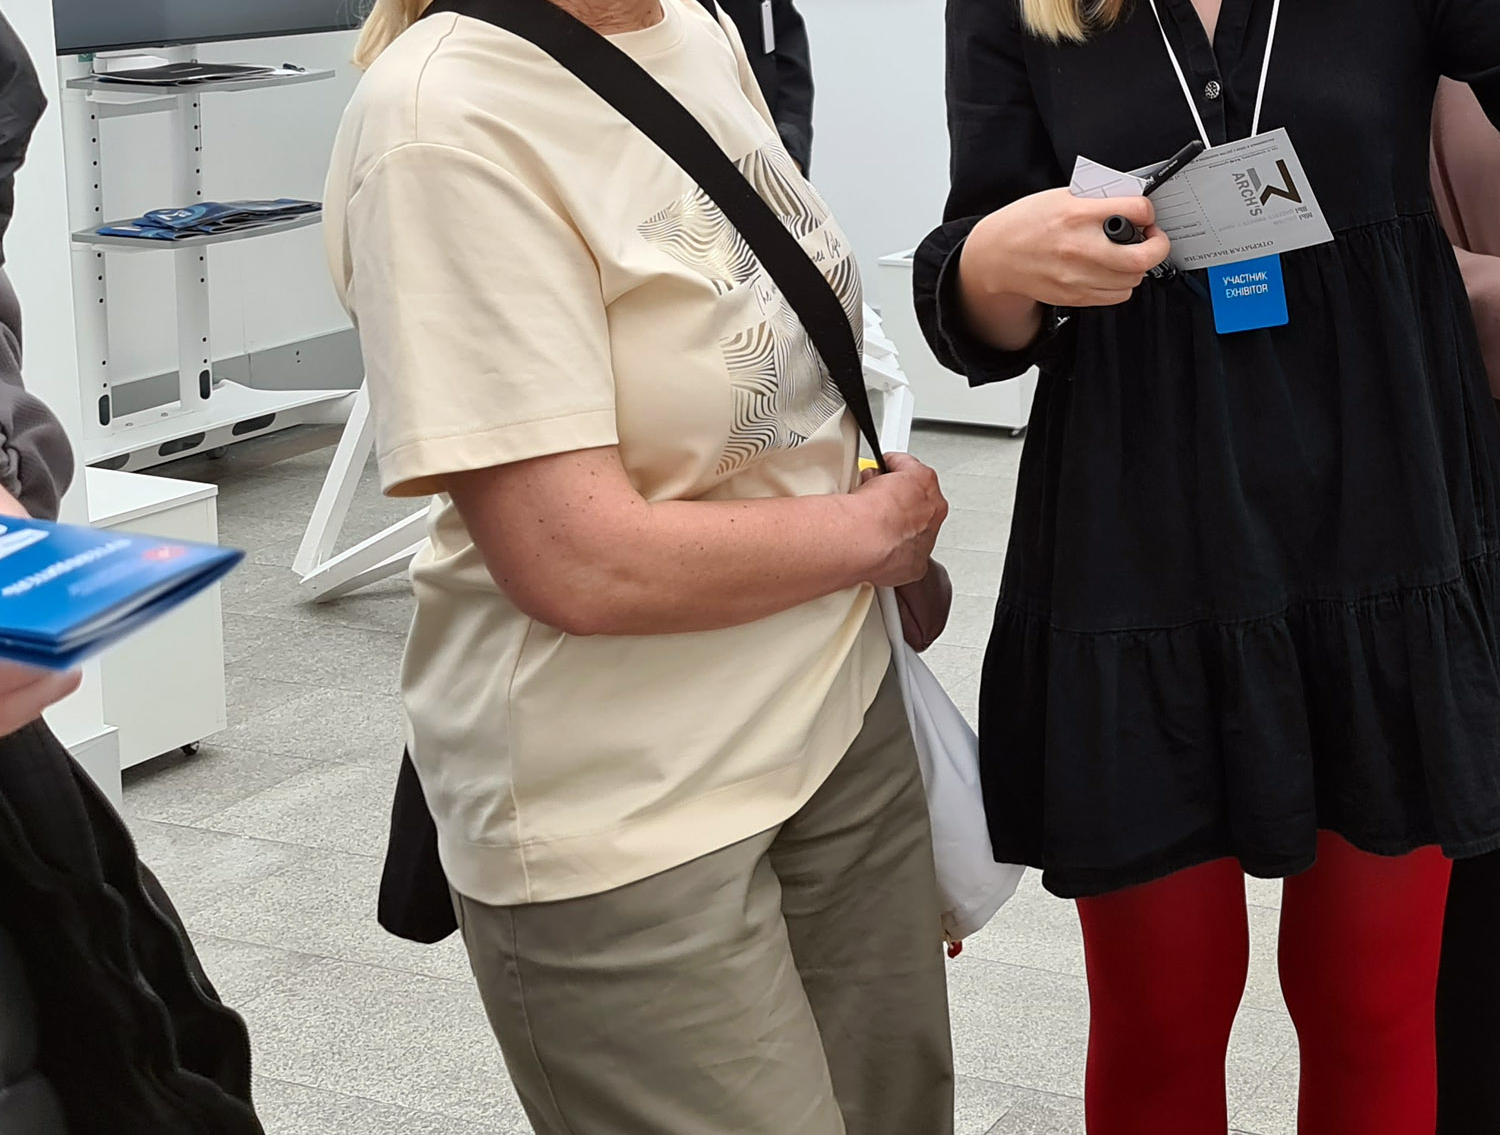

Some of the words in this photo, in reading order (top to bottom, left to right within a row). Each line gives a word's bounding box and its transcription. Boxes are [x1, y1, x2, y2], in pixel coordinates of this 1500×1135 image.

[1232, 171, 1263, 217] ARCH'S
[1222, 270, 1269, 286] УЧАСТНИК
[1225, 283, 1269, 299] EXHIBITOR
